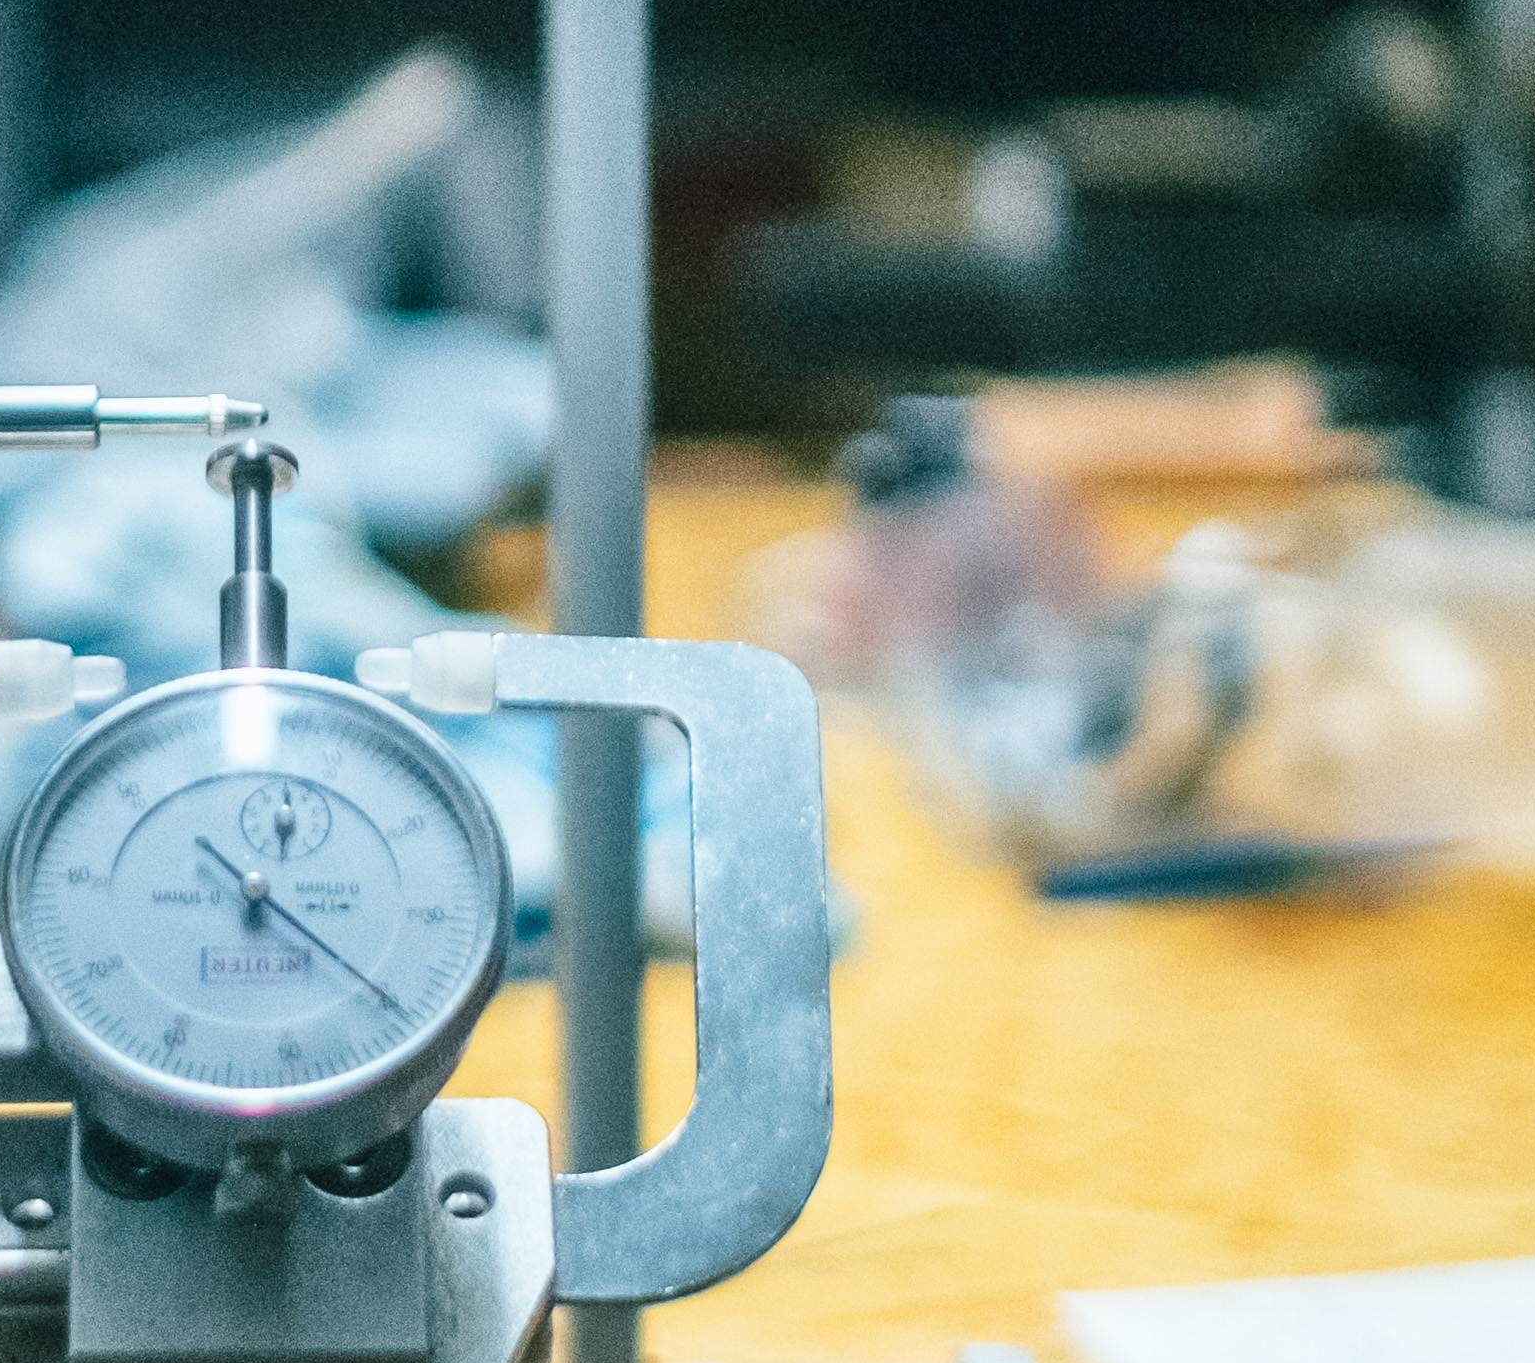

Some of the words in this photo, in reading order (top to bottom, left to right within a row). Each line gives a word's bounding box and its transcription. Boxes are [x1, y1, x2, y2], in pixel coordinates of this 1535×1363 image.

[67, 865, 90, 885] 80
[84, 958, 109, 979] 70
[211, 956, 301, 974] NEUTER
